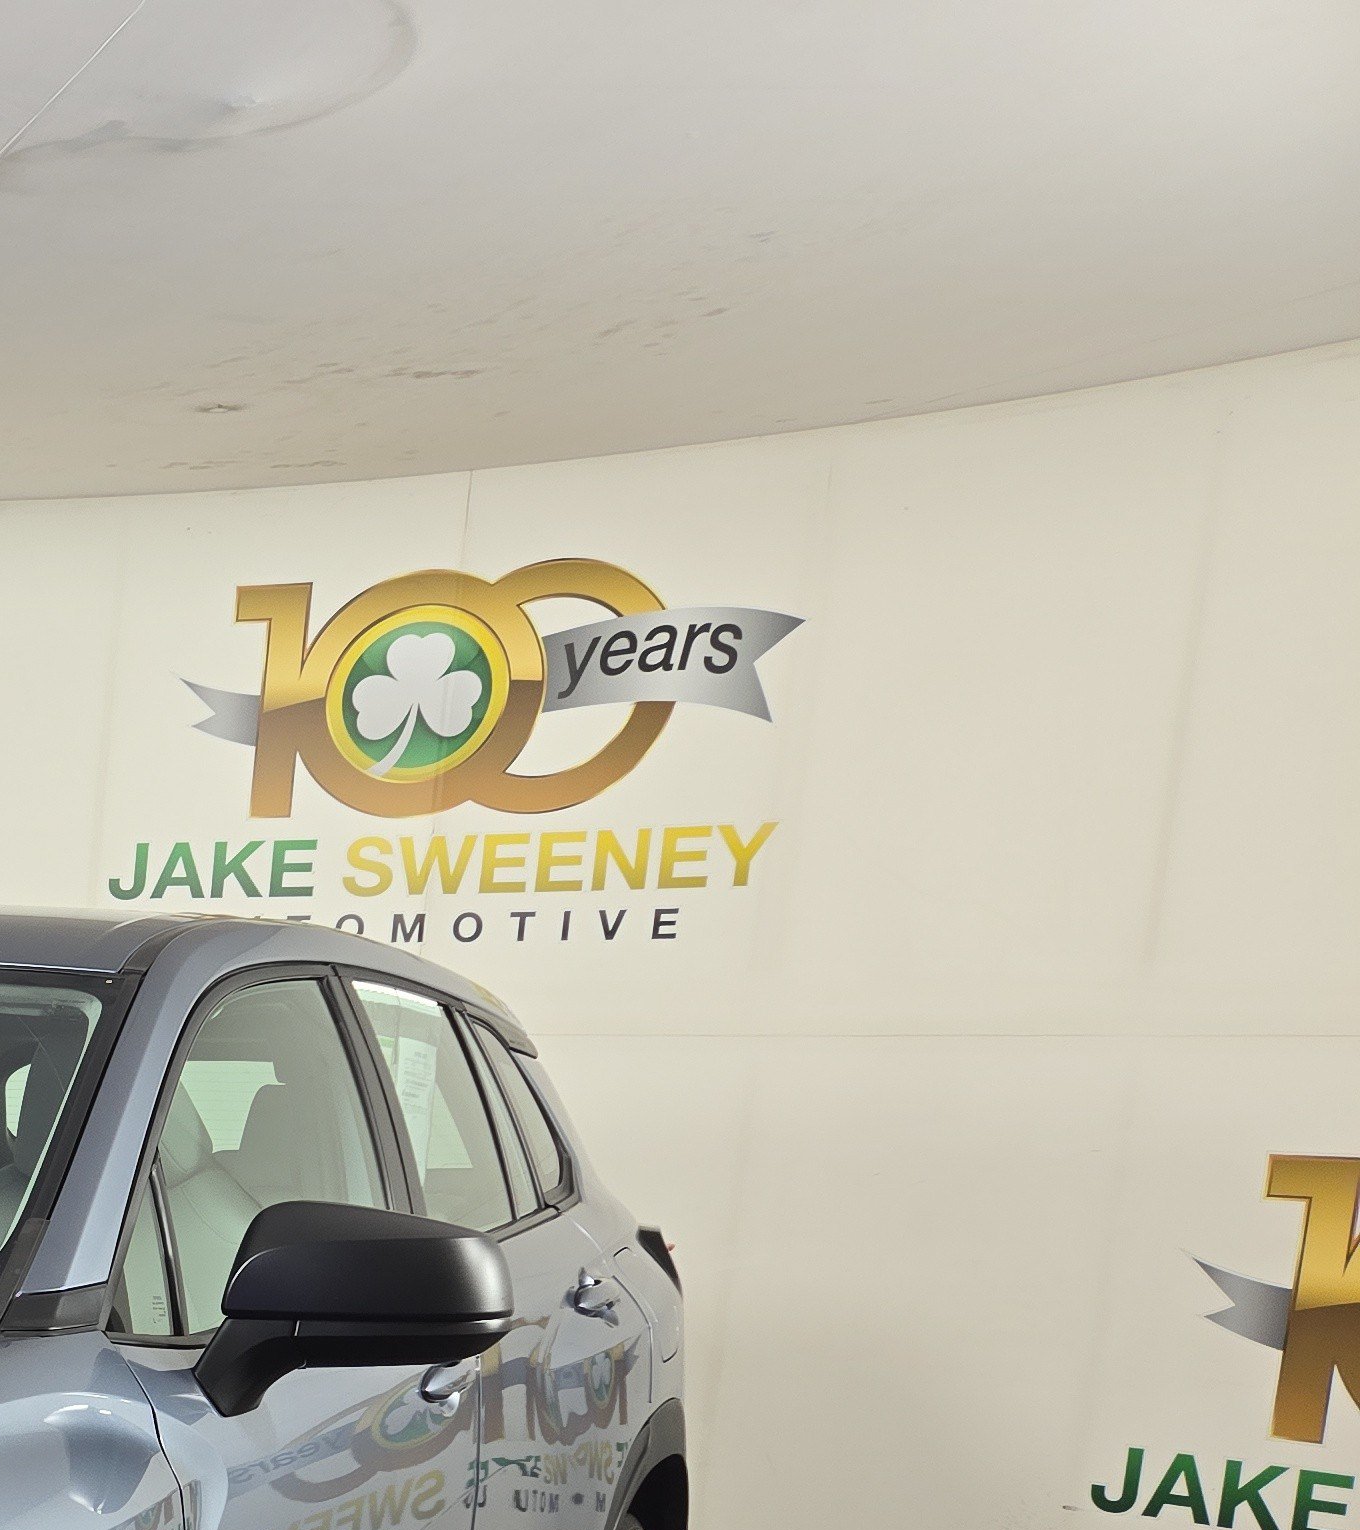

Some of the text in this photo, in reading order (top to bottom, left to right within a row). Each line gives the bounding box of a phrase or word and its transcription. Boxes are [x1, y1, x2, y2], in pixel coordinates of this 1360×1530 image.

[235, 557, 678, 819] 100
[557, 621, 744, 700] years
[108, 822, 779, 900] JAKE SWEENEY
[286, 908, 680, 944] OMOTIVE
